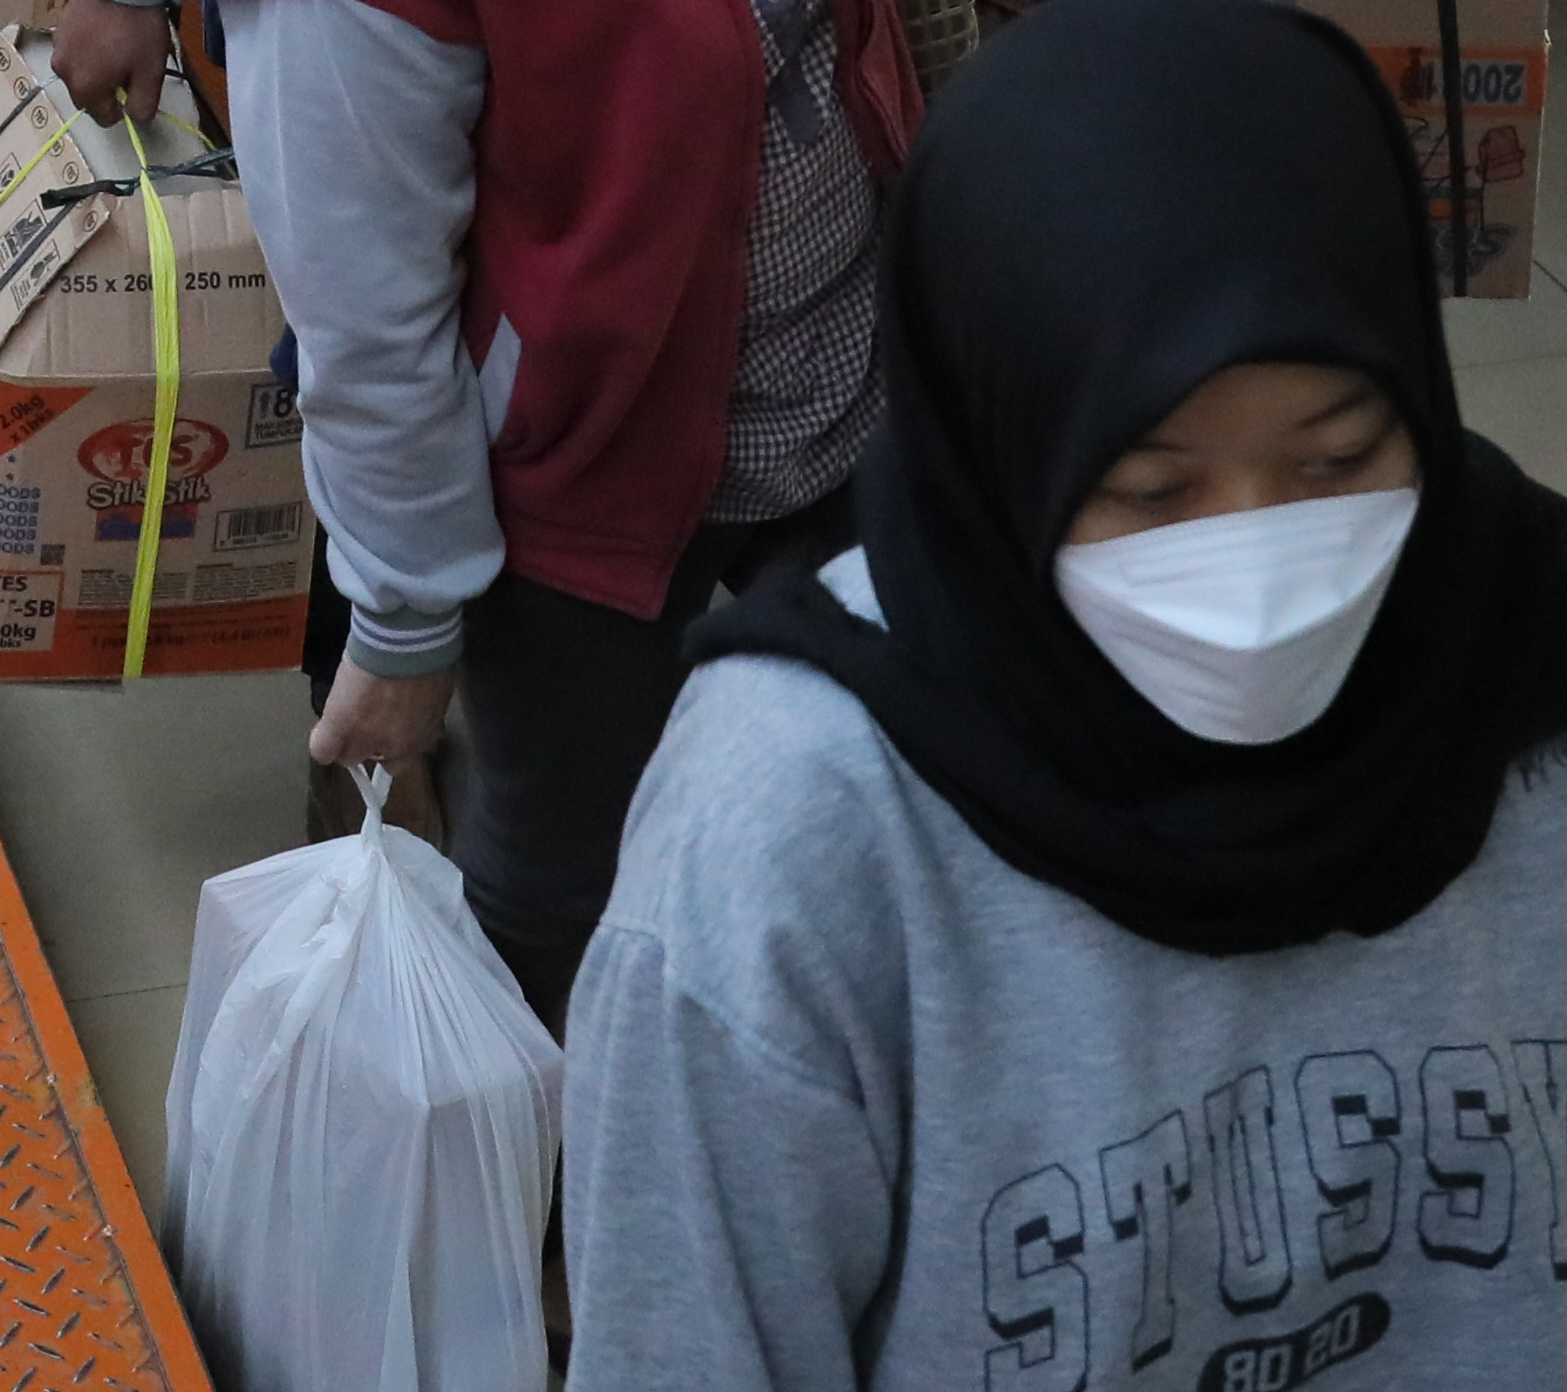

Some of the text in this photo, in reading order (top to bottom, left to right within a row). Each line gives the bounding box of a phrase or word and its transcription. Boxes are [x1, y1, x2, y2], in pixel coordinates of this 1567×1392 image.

[60, 275, 98, 293] 355
[105, 279, 118, 293] x
[185, 272, 221, 291] 250
[227, 273, 266, 289] mm
[87, 477, 146, 510] Stik
[1303, 1304, 1362, 1377] 20
